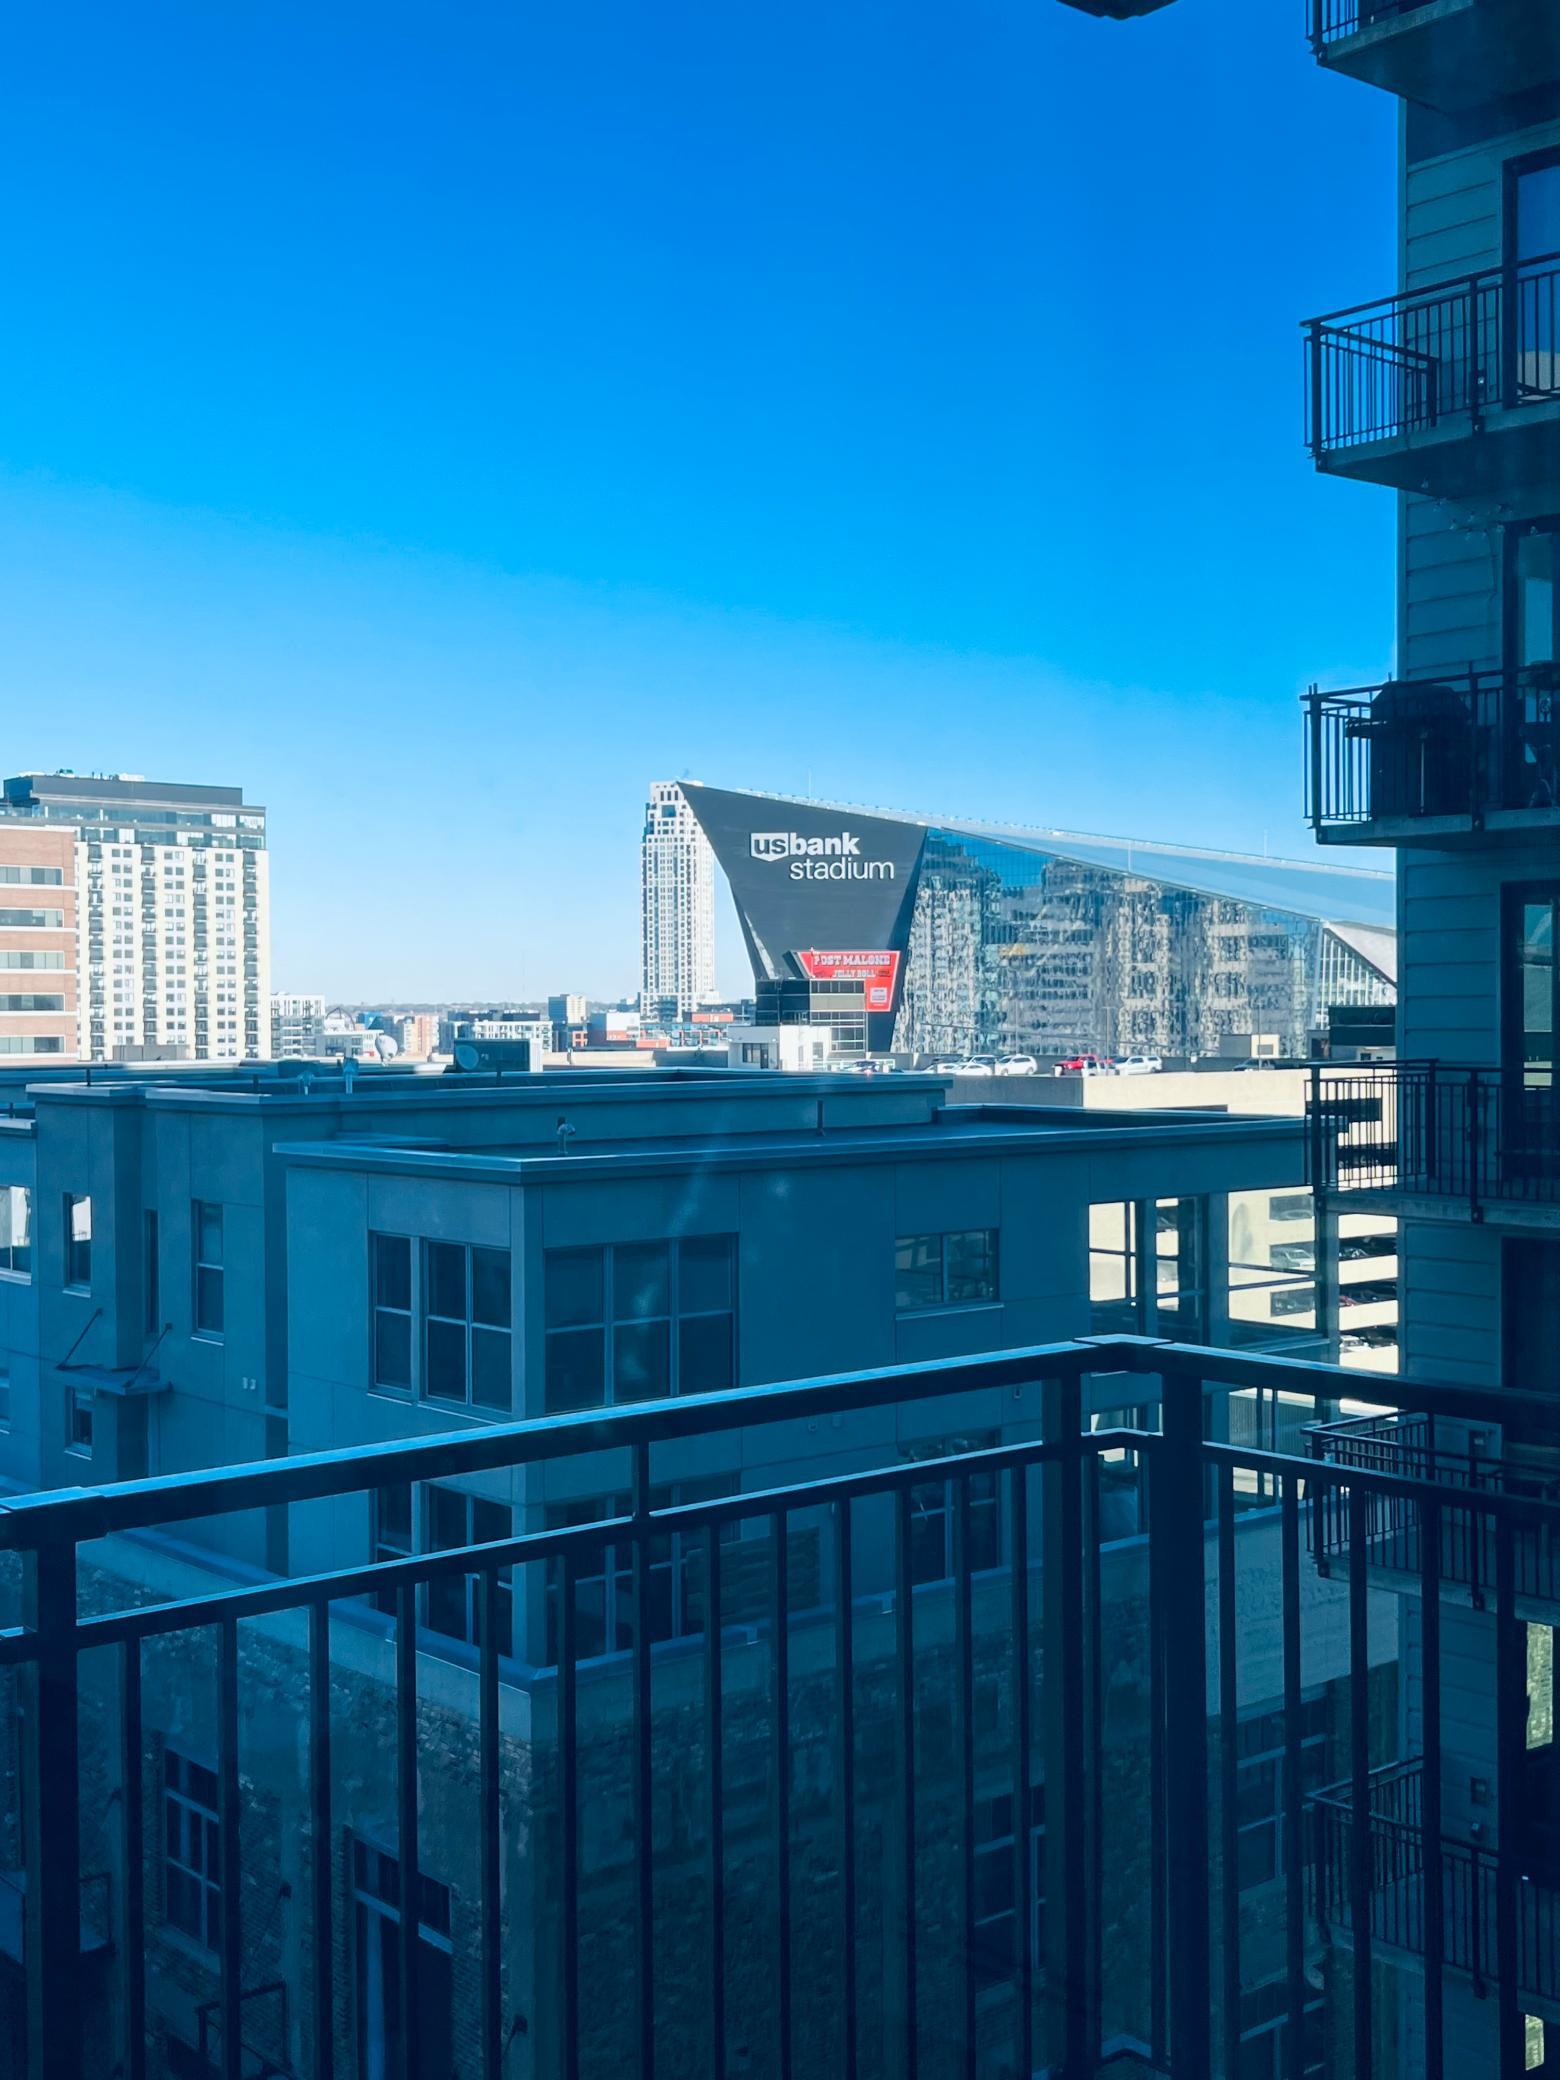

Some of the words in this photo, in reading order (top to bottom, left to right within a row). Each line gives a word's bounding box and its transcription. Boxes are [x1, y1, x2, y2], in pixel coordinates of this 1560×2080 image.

[790, 857, 895, 880] stadium
[814, 954, 841, 965] POST
[843, 955, 890, 965] MALONE
